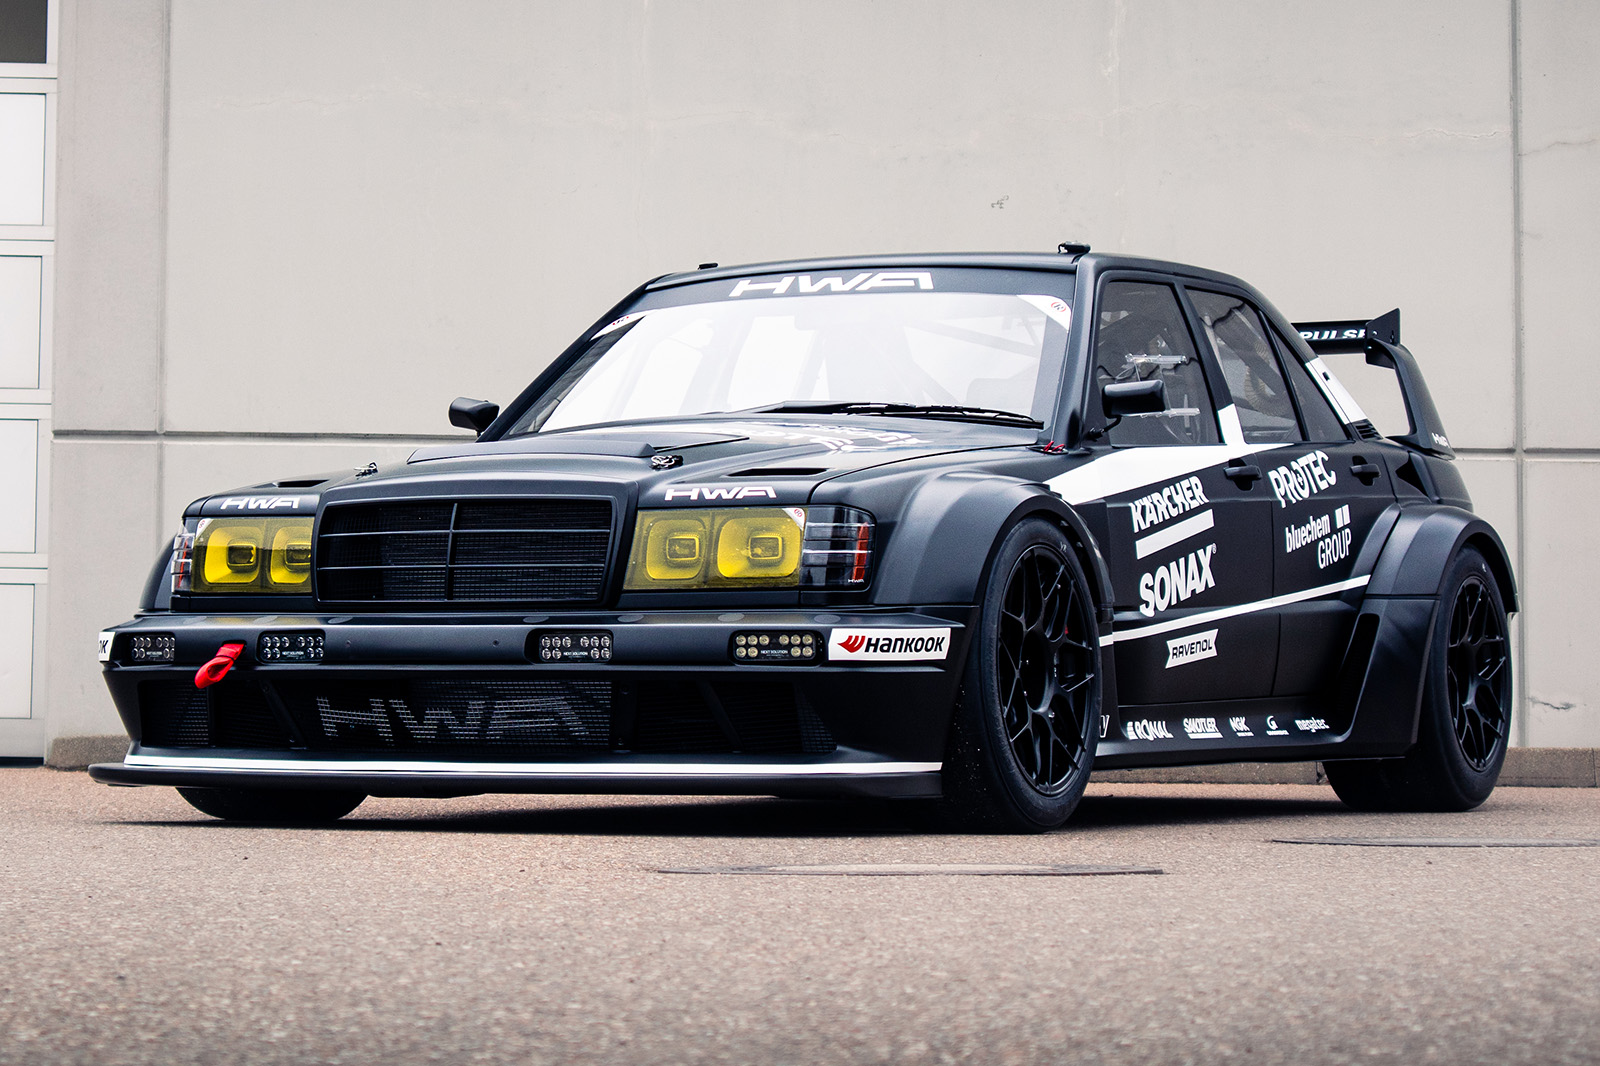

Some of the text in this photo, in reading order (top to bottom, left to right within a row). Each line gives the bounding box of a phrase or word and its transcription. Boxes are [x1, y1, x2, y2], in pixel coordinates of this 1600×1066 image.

[729, 272, 934, 297] HWA
[1268, 450, 1337, 508] PROTEC
[220, 497, 300, 509] HWA
[665, 486, 777, 501] HWA
[1128, 476, 1210, 533] KÄRCHER
[1285, 514, 1331, 553] bluechem
[1318, 528, 1352, 569] GROUP
[1171, 638, 1213, 659] RAVENOL
[316, 696, 590, 743] HWA
[1134, 719, 1174, 741] RONAL
[1229, 716, 1250, 731] NGK
